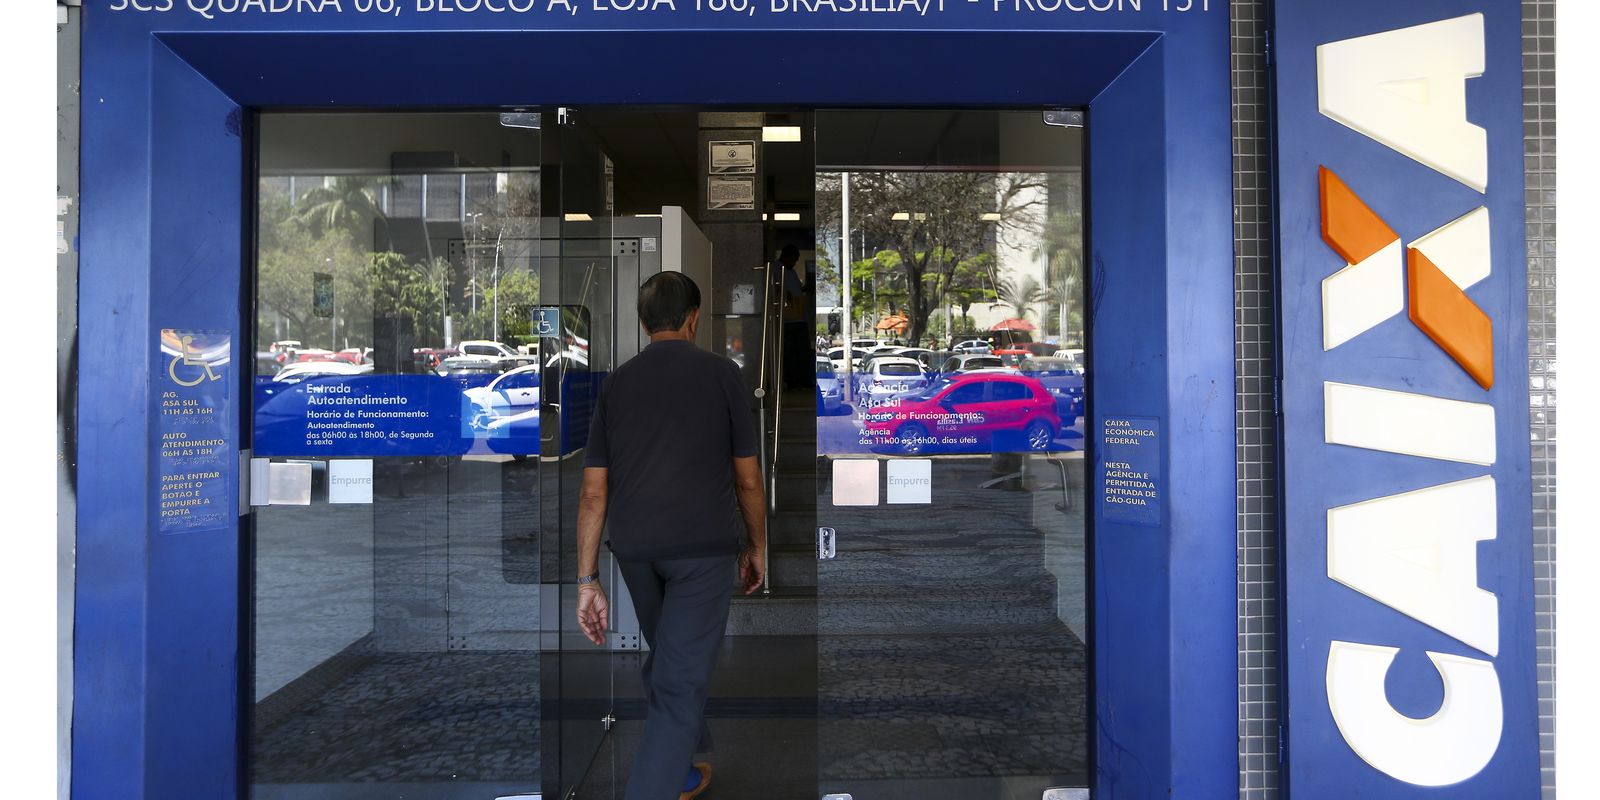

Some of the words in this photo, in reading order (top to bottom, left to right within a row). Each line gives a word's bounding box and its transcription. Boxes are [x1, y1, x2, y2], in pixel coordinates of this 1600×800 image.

[306, 383, 351, 394] Entrada
[307, 394, 408, 405] Autoatendimento
[1317, 12, 1505, 788] CAIXA
[306, 409, 341, 419] Horário
[343, 410, 356, 418] de
[357, 410, 430, 418] Funcionamento:
[895, 411, 907, 420] de
[909, 411, 982, 420] Funcionamento:
[307, 421, 375, 429] Autoatendimento
[162, 432, 187, 440] AUTO
[321, 431, 347, 439] 06h00
[360, 431, 387, 440] 18h00,
[400, 430, 434, 440] Segunda
[859, 428, 891, 437] Agência
[162, 439, 224, 449] ATENDIMENTO
[859, 437, 873, 445] das
[941, 436, 958, 444] dias
[1105, 437, 1140, 445] FEDERAL
[1105, 462, 1131, 470] NESTA
[162, 474, 185, 482] PARA
[187, 471, 220, 480] ENTRAR
[331, 475, 372, 487] Empurre
[888, 475, 930, 487] Empurre
[162, 482, 193, 491] APERTE
[1105, 479, 1148, 489] PERMITIDA
[1105, 487, 1144, 497] ENTRADA
[1145, 489, 1156, 498] DE
[162, 498, 202, 508] EMPURRE
[162, 508, 190, 517] PORTA
